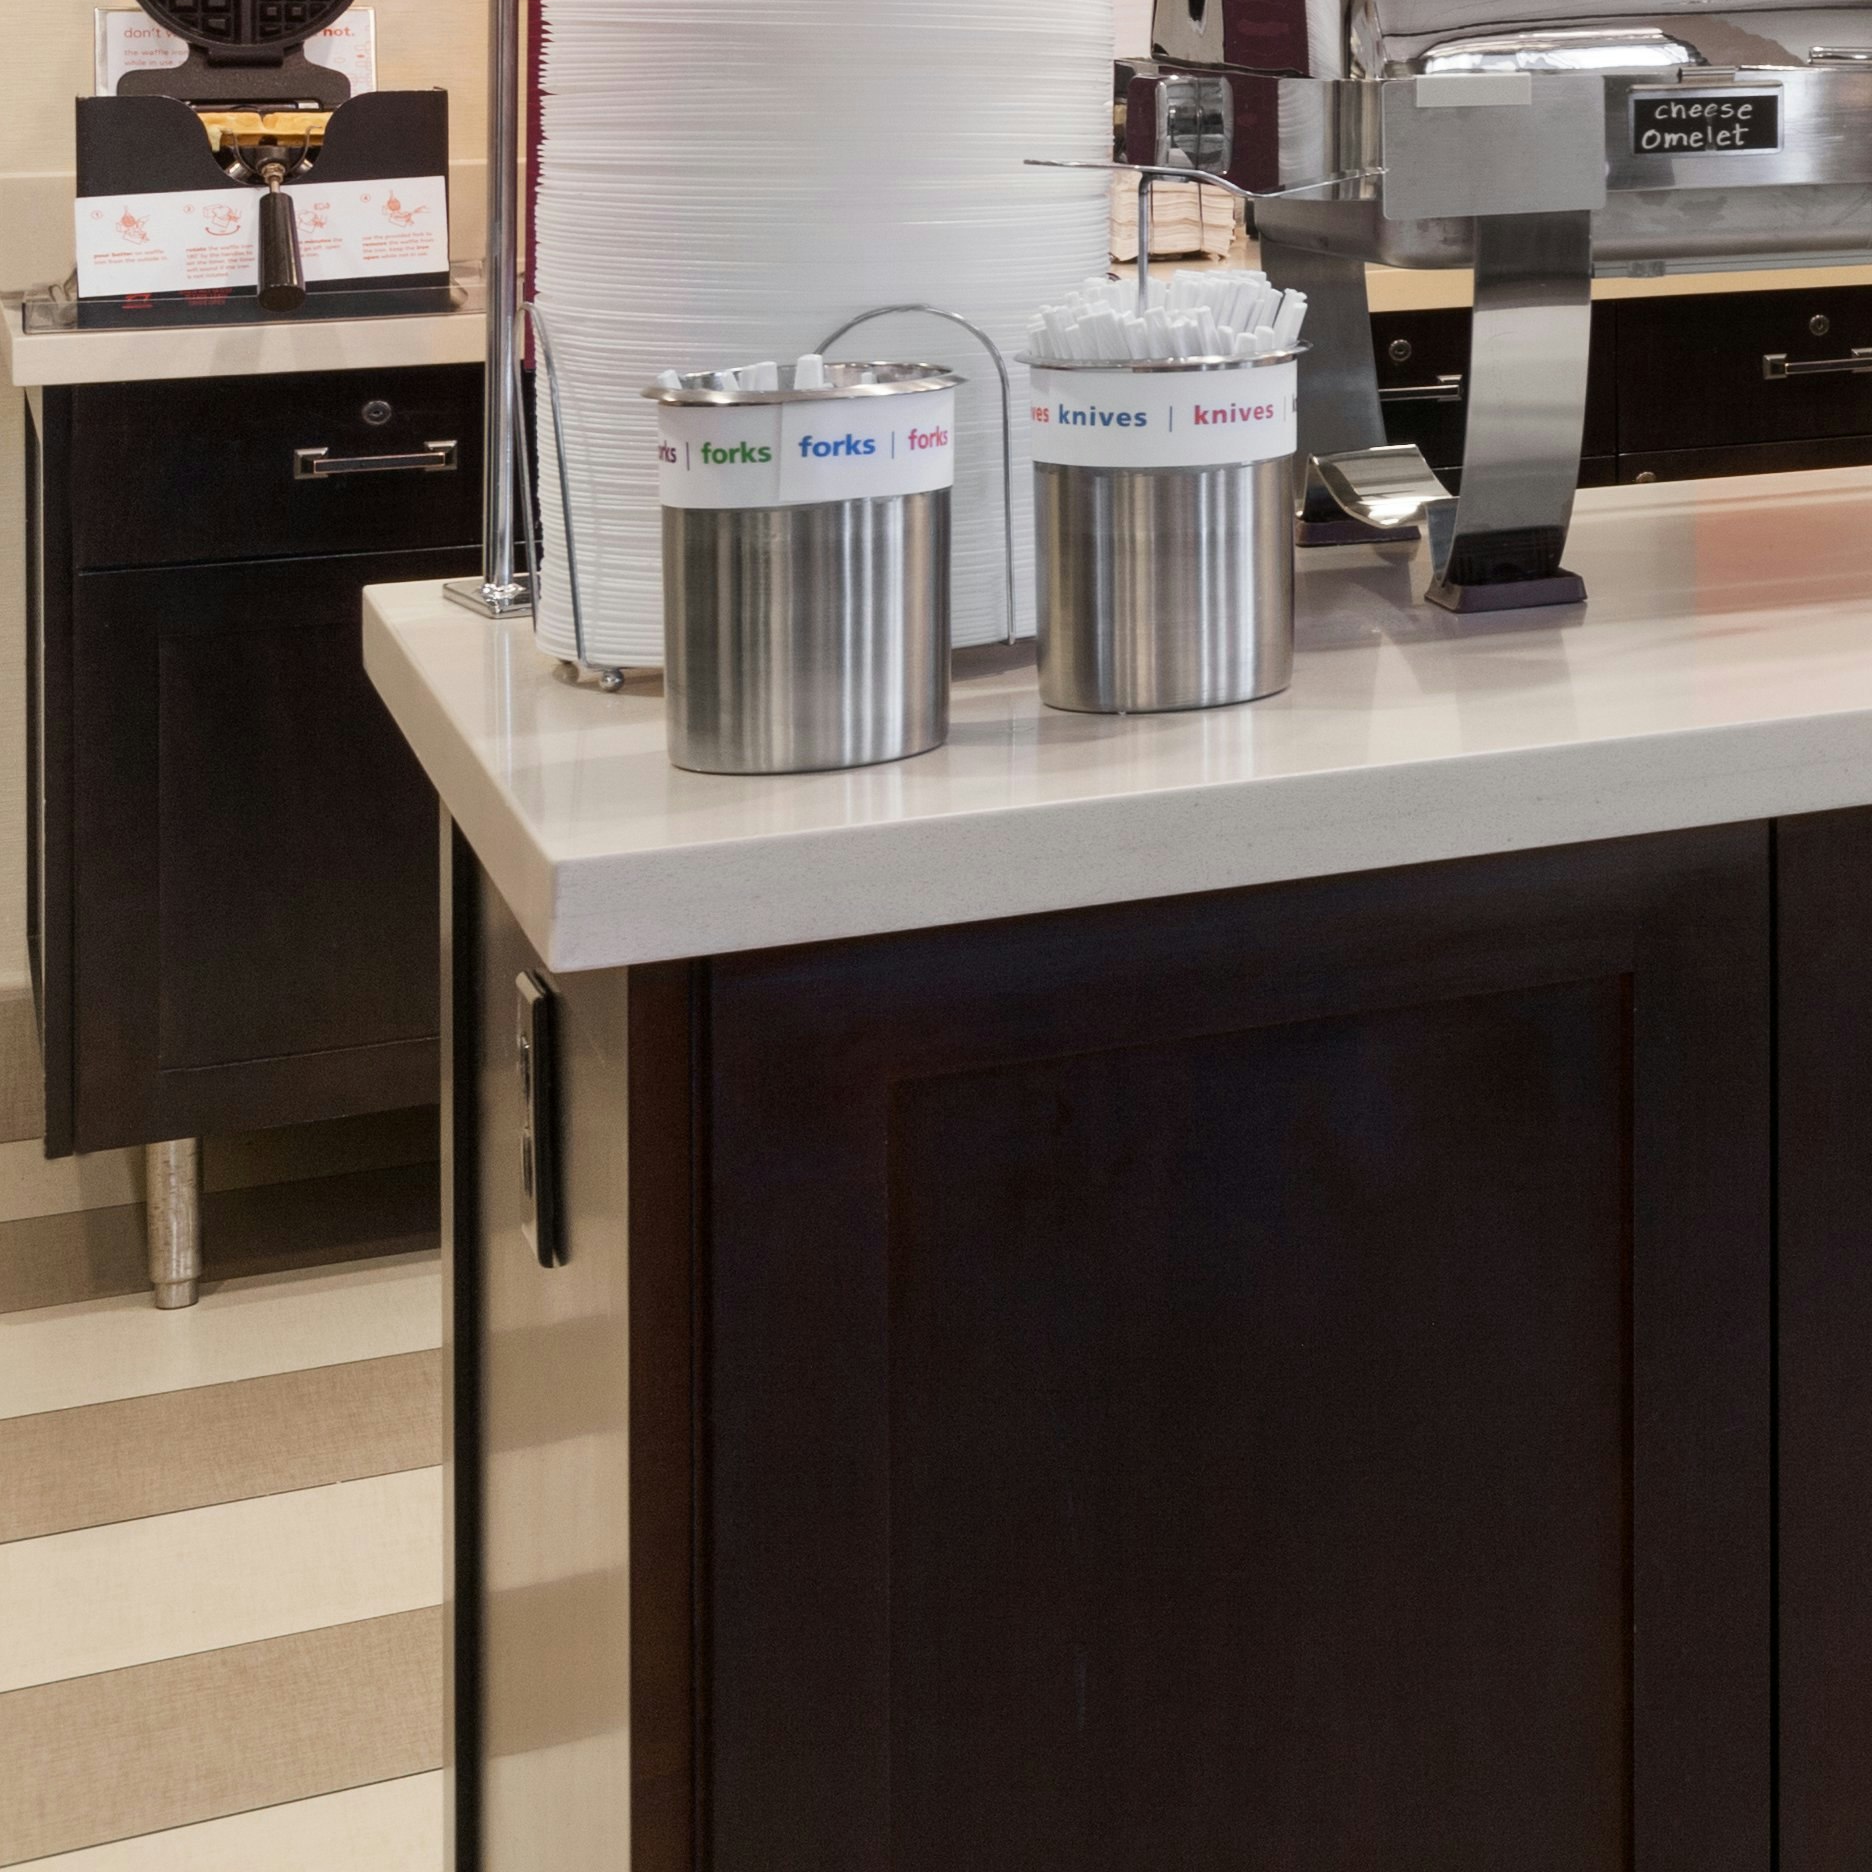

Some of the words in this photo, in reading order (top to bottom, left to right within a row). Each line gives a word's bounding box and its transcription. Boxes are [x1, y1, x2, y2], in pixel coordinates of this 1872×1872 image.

[124, 27, 161, 38] don't
[1654, 101, 1753, 120] cheese
[1641, 123, 1749, 150] Omelet
[1031, 406, 1050, 424] ves
[1058, 404, 1148, 428] knives
[1193, 402, 1274, 425] knives
[658, 440, 677, 464] rks
[701, 441, 772, 465] forks
[799, 434, 877, 458] forks
[908, 426, 949, 451] forks
